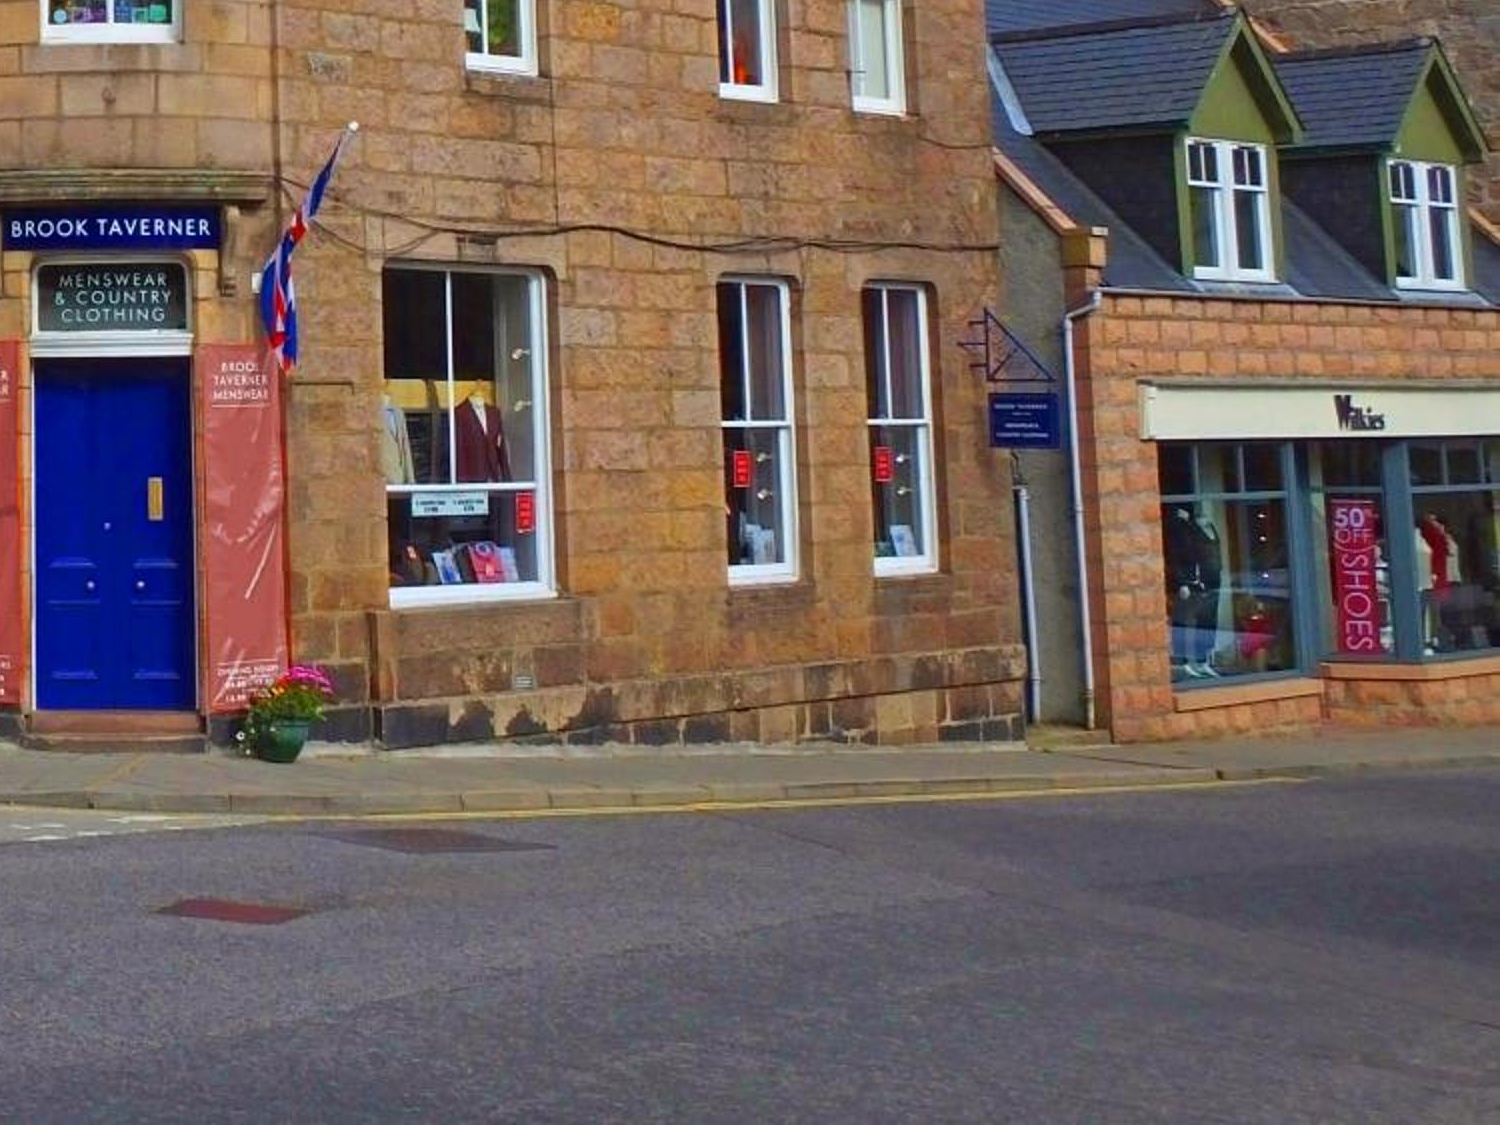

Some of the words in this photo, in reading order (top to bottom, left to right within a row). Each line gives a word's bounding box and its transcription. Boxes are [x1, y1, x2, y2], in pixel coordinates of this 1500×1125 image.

[10, 219, 89, 238] BROOK
[96, 218, 212, 236] TAVERNER
[59, 273, 167, 288] MENSWEAR
[55, 292, 66, 306] &
[75, 290, 171, 305] COUNTRY
[61, 307, 165, 322] CLOTHING
[213, 374, 269, 386] TAVERNER
[1333, 394, 1385, 431] Wilkies
[1334, 528, 1373, 544] OFF
[1341, 554, 1373, 650] SHOES
